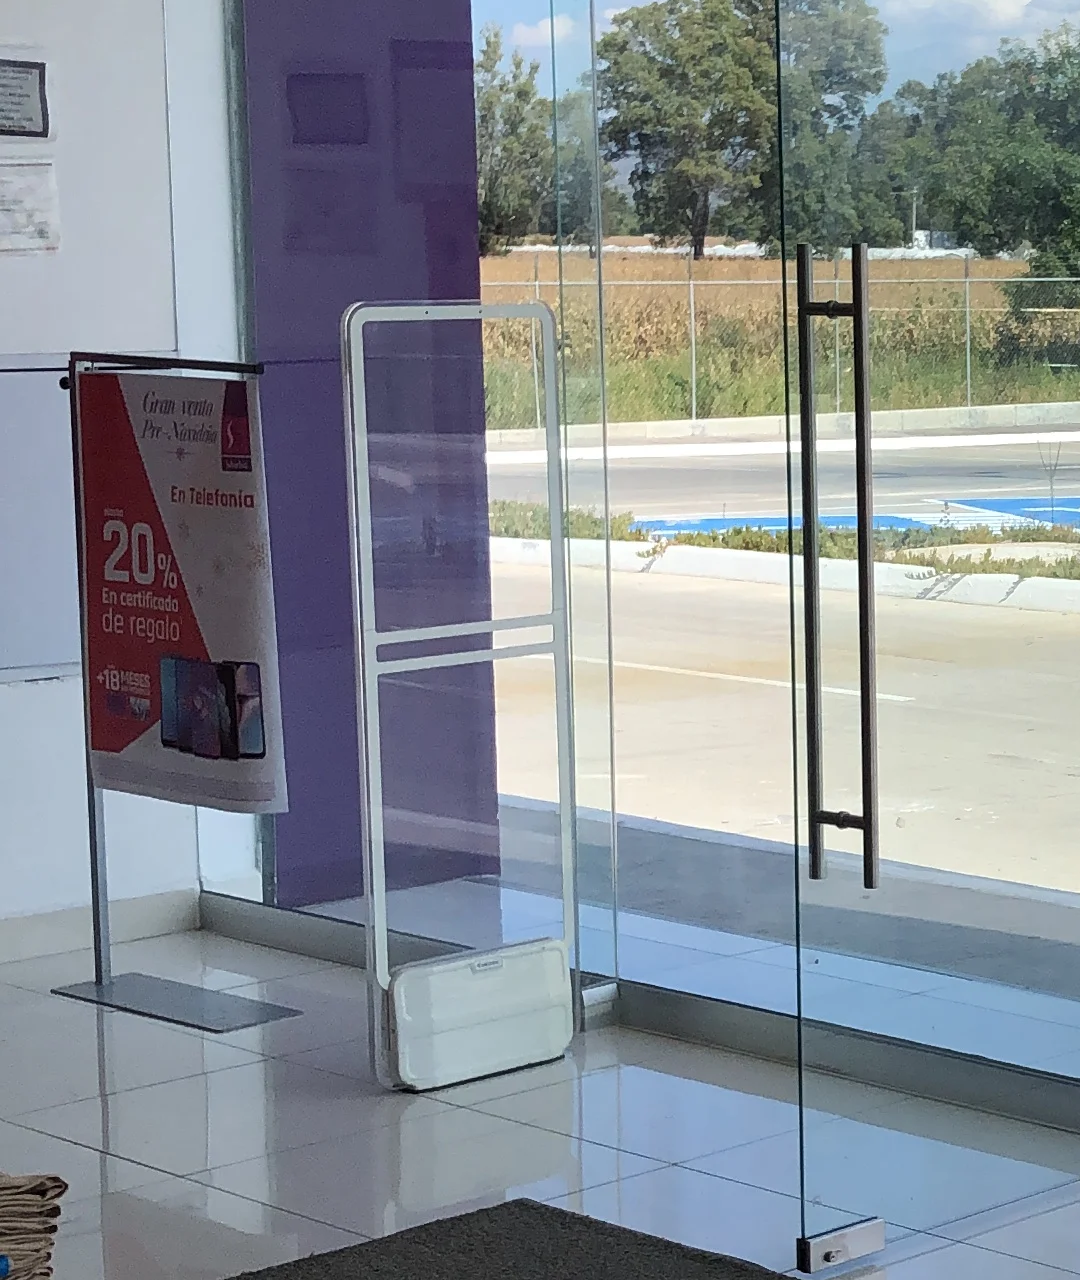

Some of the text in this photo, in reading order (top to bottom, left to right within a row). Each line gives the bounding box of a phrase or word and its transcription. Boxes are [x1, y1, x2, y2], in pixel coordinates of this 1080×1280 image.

[142, 390, 176, 415] Gran
[170, 485, 186, 503] En
[103, 519, 178, 590] 20%
[102, 587, 179, 613] En certificado
[102, 608, 124, 634] de
[96, 669, 120, 691] +18
